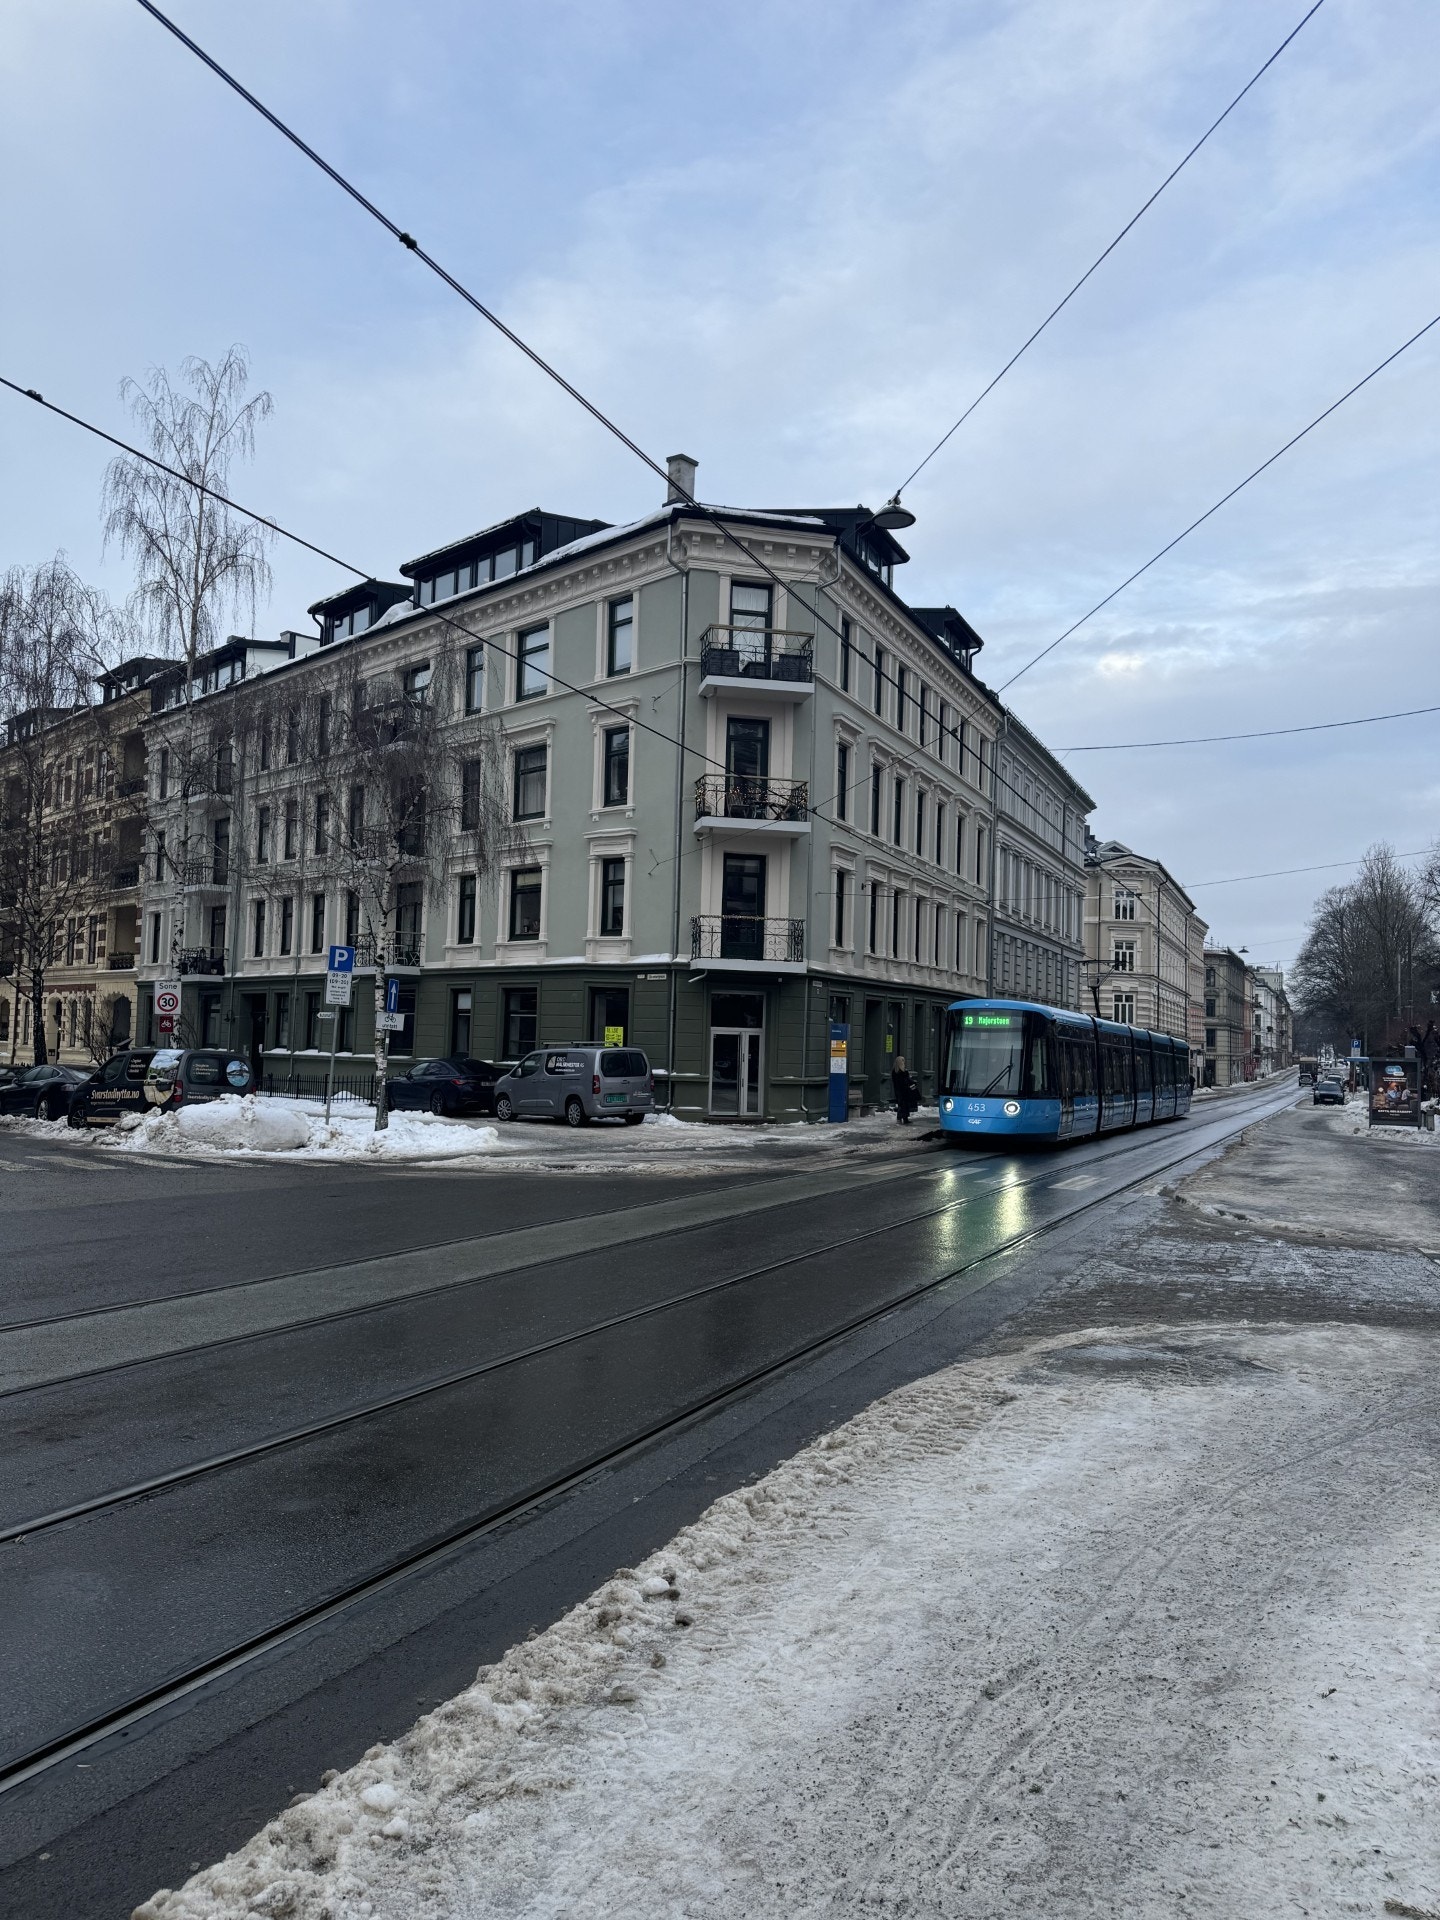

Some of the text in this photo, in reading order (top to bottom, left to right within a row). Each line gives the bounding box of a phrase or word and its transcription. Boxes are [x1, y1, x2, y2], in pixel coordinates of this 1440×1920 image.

[334, 949, 348, 968] P
[159, 982, 178, 990] Sone
[161, 997, 175, 1008] 30
[964, 1016, 973, 1025] 19
[1353, 1040, 1359, 1048] P
[967, 1103, 986, 1112] 453
